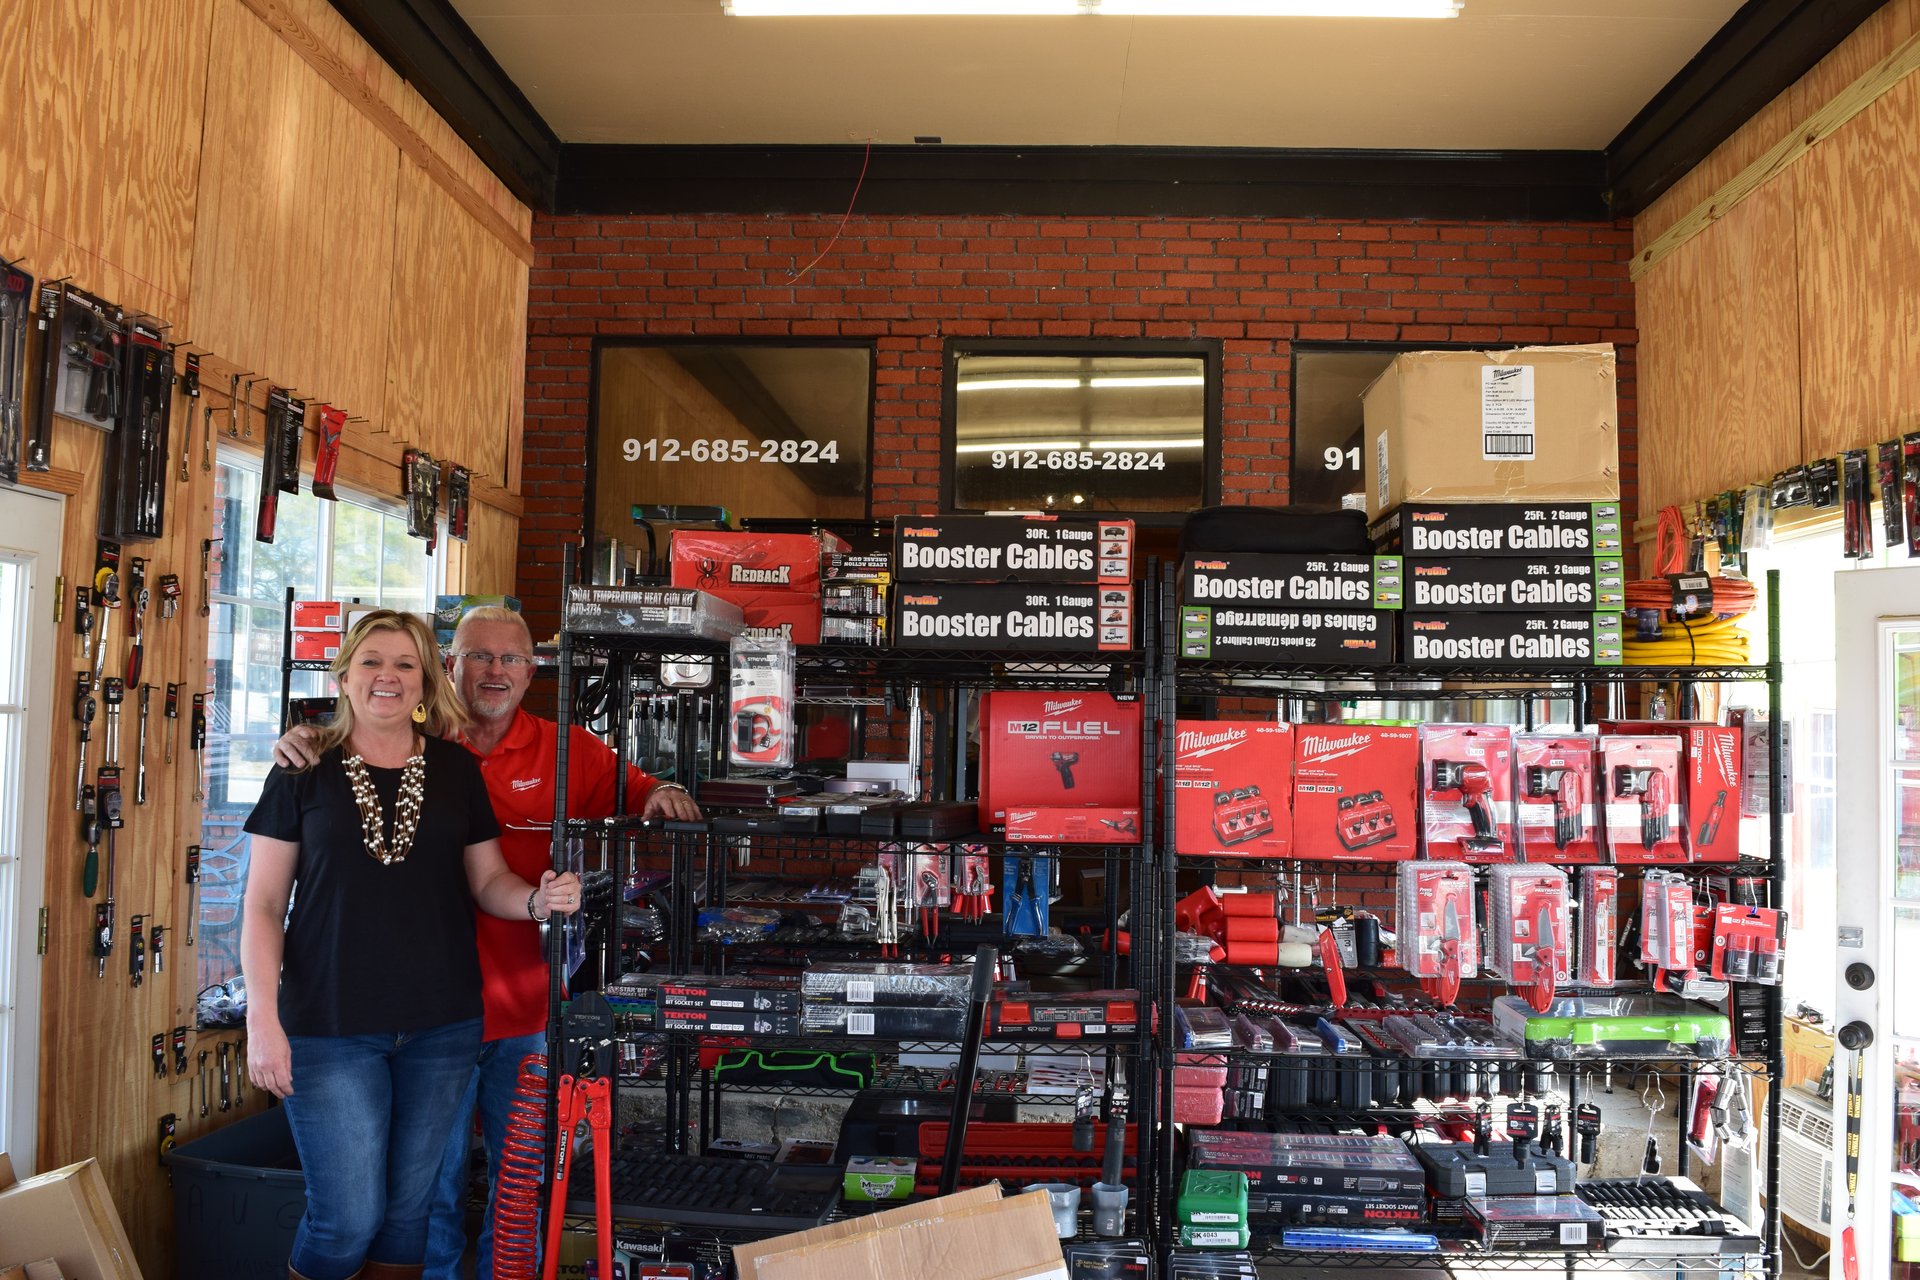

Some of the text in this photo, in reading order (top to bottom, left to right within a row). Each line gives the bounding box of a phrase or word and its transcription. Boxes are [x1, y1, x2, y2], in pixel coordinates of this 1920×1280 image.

[6, 274, 25, 292] ATD
[1493, 367, 1523, 378] Milwaukee
[623, 438, 839, 463] 912-685-2824
[991, 451, 1165, 471] 912-685-2824
[1324, 446, 1360, 470] 91
[1412, 512, 1445, 522] ProGlo
[1524, 510, 1587, 522] 25Ft. 2 Gauge
[904, 527, 938, 537] ProGlo
[1026, 528, 1093, 541] 30Ft. 1 Gauge
[1413, 525, 1589, 550] Booster Cables
[903, 543, 1094, 570] Booster Cables
[1194, 561, 1226, 570] ProGlo
[1306, 561, 1369, 574] 25Ft. 2 Gauge
[1415, 566, 1447, 576] ProGlo
[1527, 565, 1591, 576] 25Ft. 2 Gauge
[1193, 575, 1369, 600] Booster Cables
[1415, 579, 1592, 605] Booster Cables
[572, 589, 590, 602] DUAL
[593, 590, 642, 604] TEMPERATURE
[644, 592, 662, 605] HEAT
[664, 593, 680, 606] GUN
[904, 595, 938, 605] ProGlo
[1026, 595, 1093, 607] 30Ft. 1 Gauge
[570, 603, 601, 616] ATD-3736
[903, 611, 1094, 638] Booster Cables
[1215, 610, 1377, 631] Câbles de démarrage
[1414, 621, 1446, 631] ProGlo
[1526, 620, 1589, 631] 25Ft. 2 Gauge
[1215, 636, 1316, 647] 25 pieds (7,6m) Calibre 2
[1414, 634, 1590, 659] Booster Cables
[1043, 699, 1083, 713] Milwaukee
[1009, 721, 1120, 735] M12 FUEL
[1176, 727, 1247, 752] Milwaukee
[1300, 732, 1372, 757] Milwaukee
[1717, 731, 1738, 787] Milwaukee
[510, 778, 541, 790] Milwaukee
[1010, 811, 1037, 821] Milwaukee
[664, 987, 706, 996] TEKTON
[664, 1011, 706, 1020] TEKTON
[559, 1130, 567, 1164] TEKTON
[861, 1181, 893, 1189] MONSTER
[1364, 1210, 1420, 1219] TEKTON
[616, 1240, 663, 1253] Kawasaki
